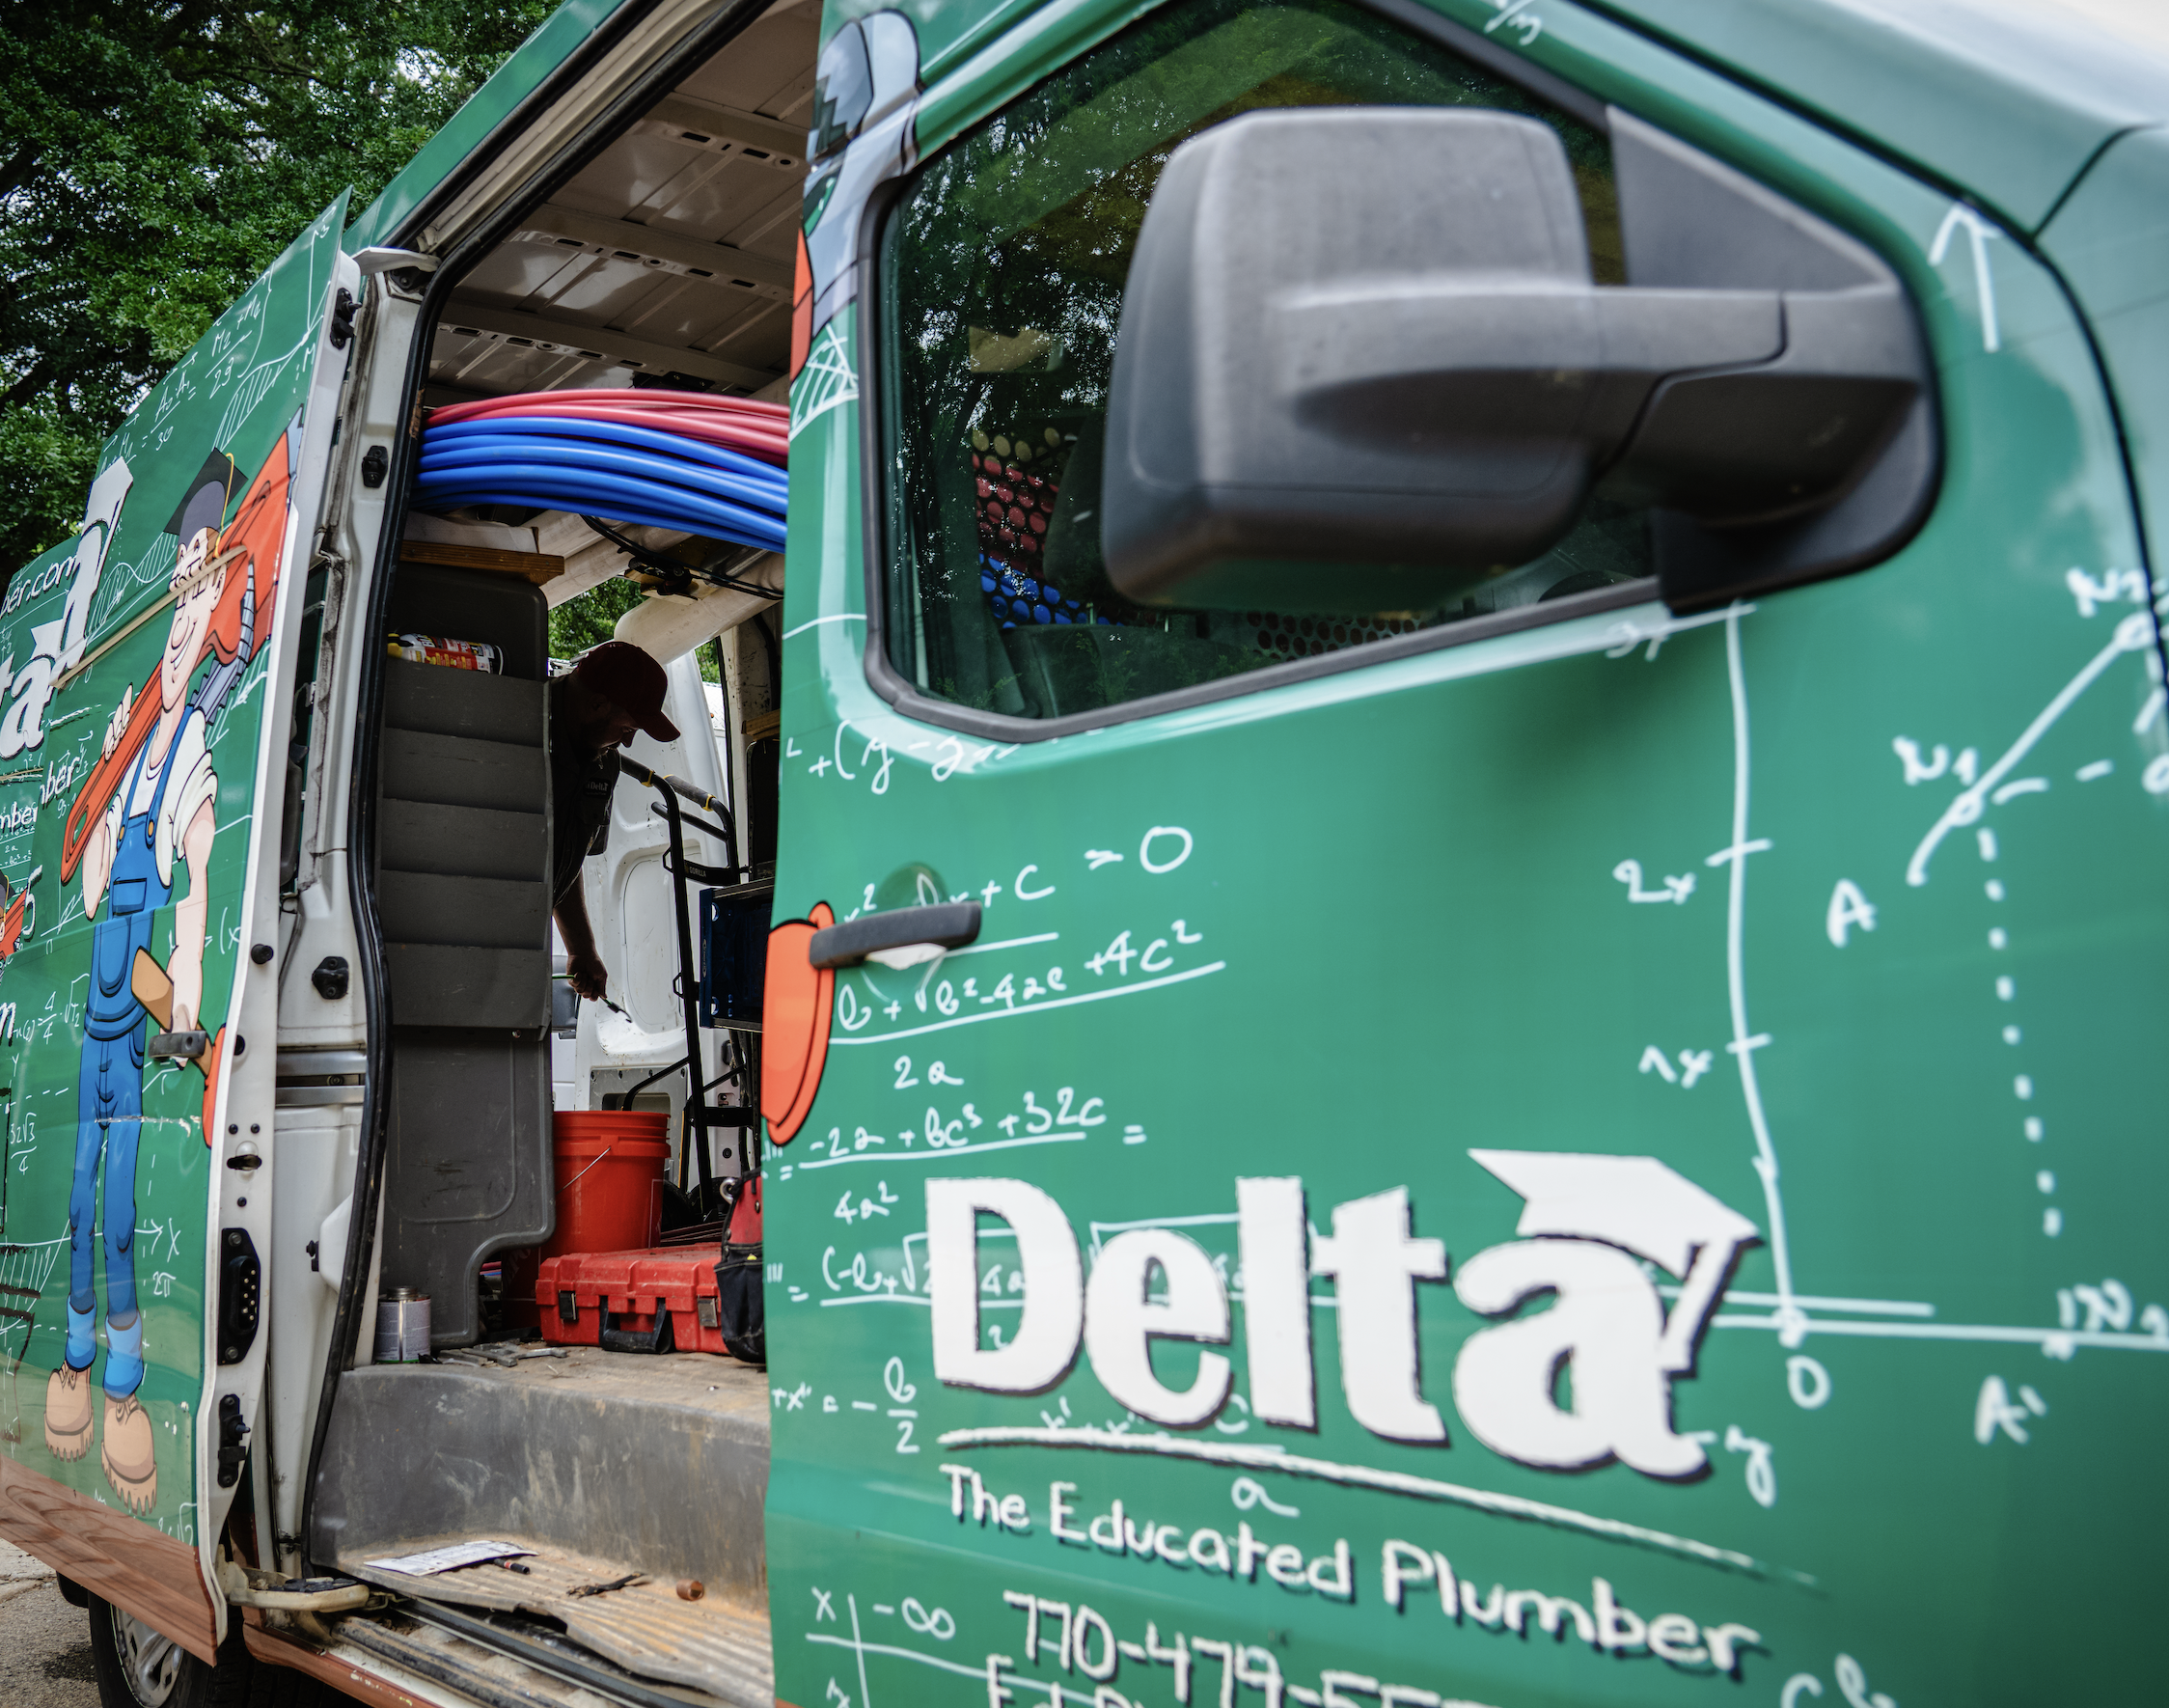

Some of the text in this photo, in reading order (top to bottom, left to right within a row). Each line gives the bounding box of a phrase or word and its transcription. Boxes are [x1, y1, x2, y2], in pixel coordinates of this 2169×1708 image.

[925, 1153, 1732, 1478] Delta
[940, 1463, 1762, 1671] The Educated Plumber
